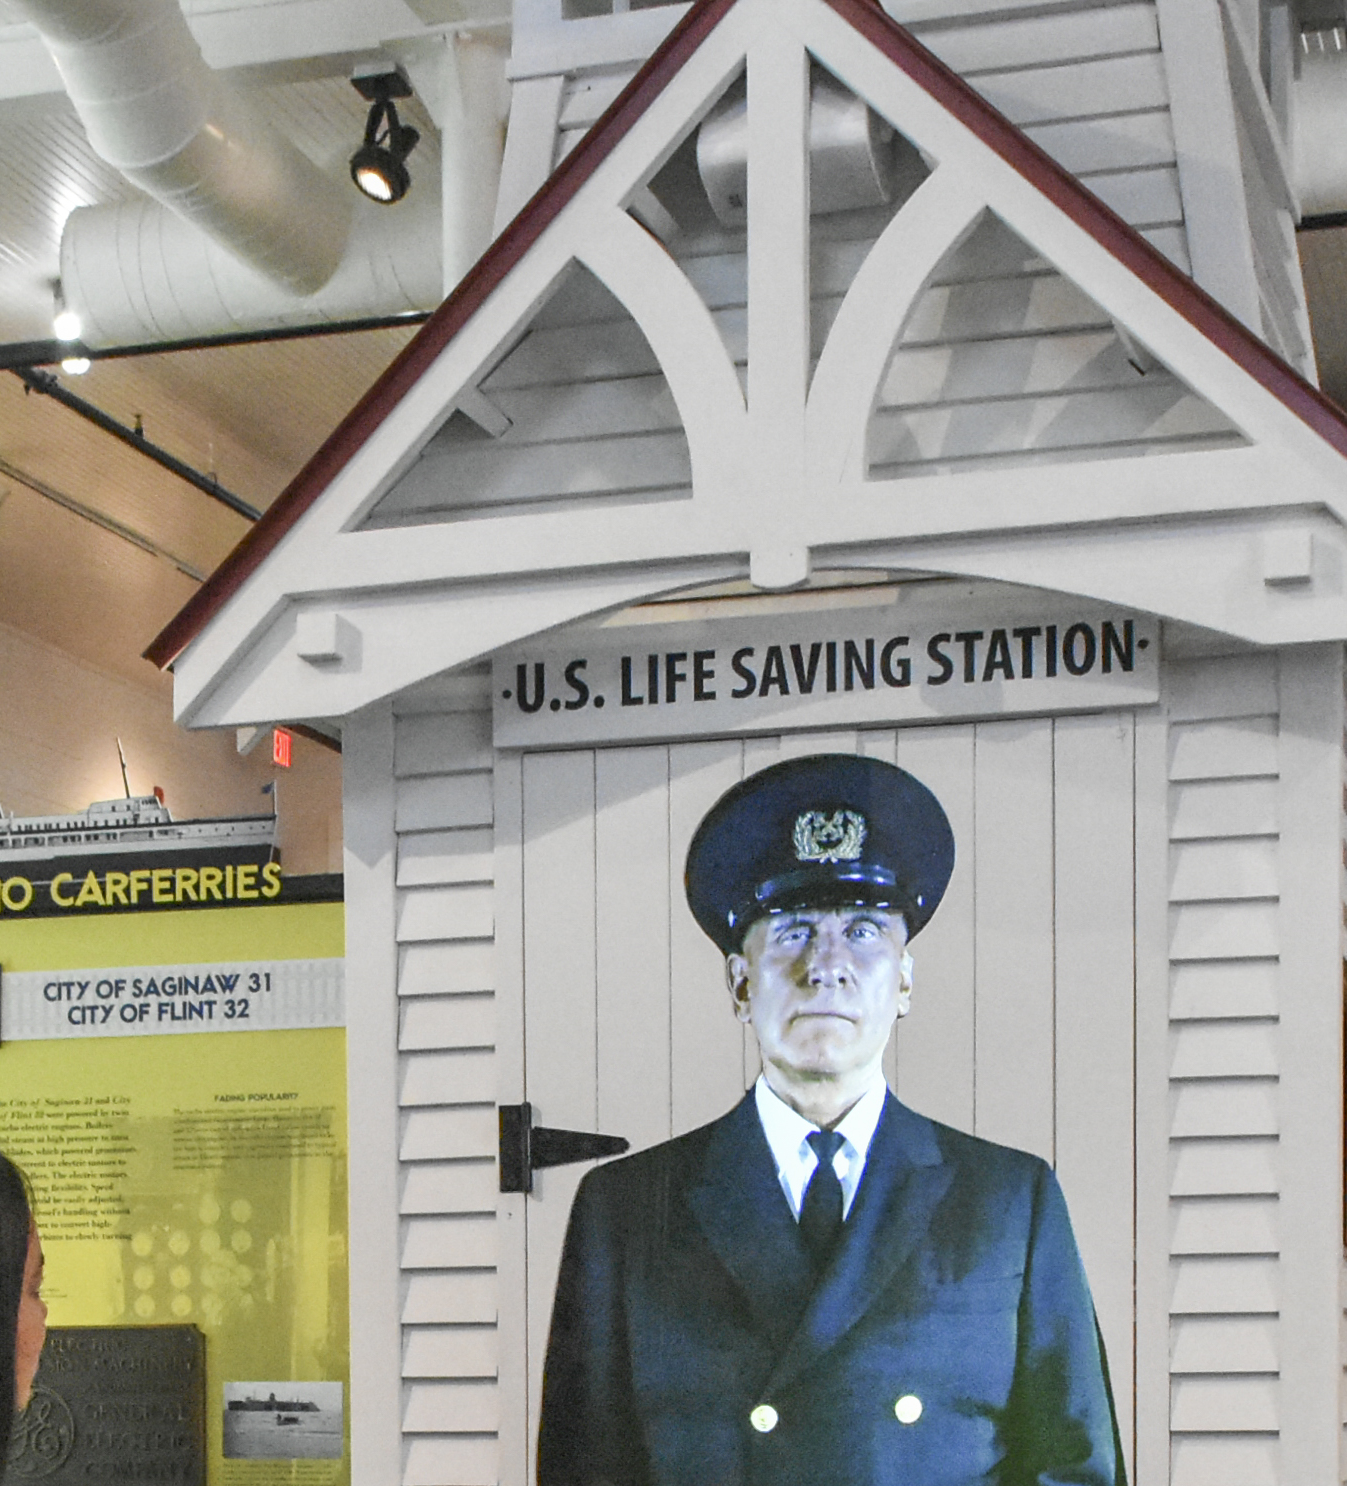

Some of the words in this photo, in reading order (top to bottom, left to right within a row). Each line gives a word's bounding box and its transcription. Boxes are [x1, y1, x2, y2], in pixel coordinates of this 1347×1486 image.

[516, 662, 606, 714] U.S.
[620, 648, 717, 707] LIFE
[731, 634, 912, 700] SAVING
[926, 618, 1136, 687] STATION
[49, 861, 284, 909] CARFERRIES
[43, 978, 89, 1003] CITY
[95, 976, 126, 998] OF
[131, 971, 242, 998] SAGINAW
[248, 971, 273, 994] 31
[67, 1001, 112, 1026] CITY
[118, 1001, 148, 1023] OF
[153, 998, 217, 1023] FLINT
[223, 996, 250, 1020] 32
